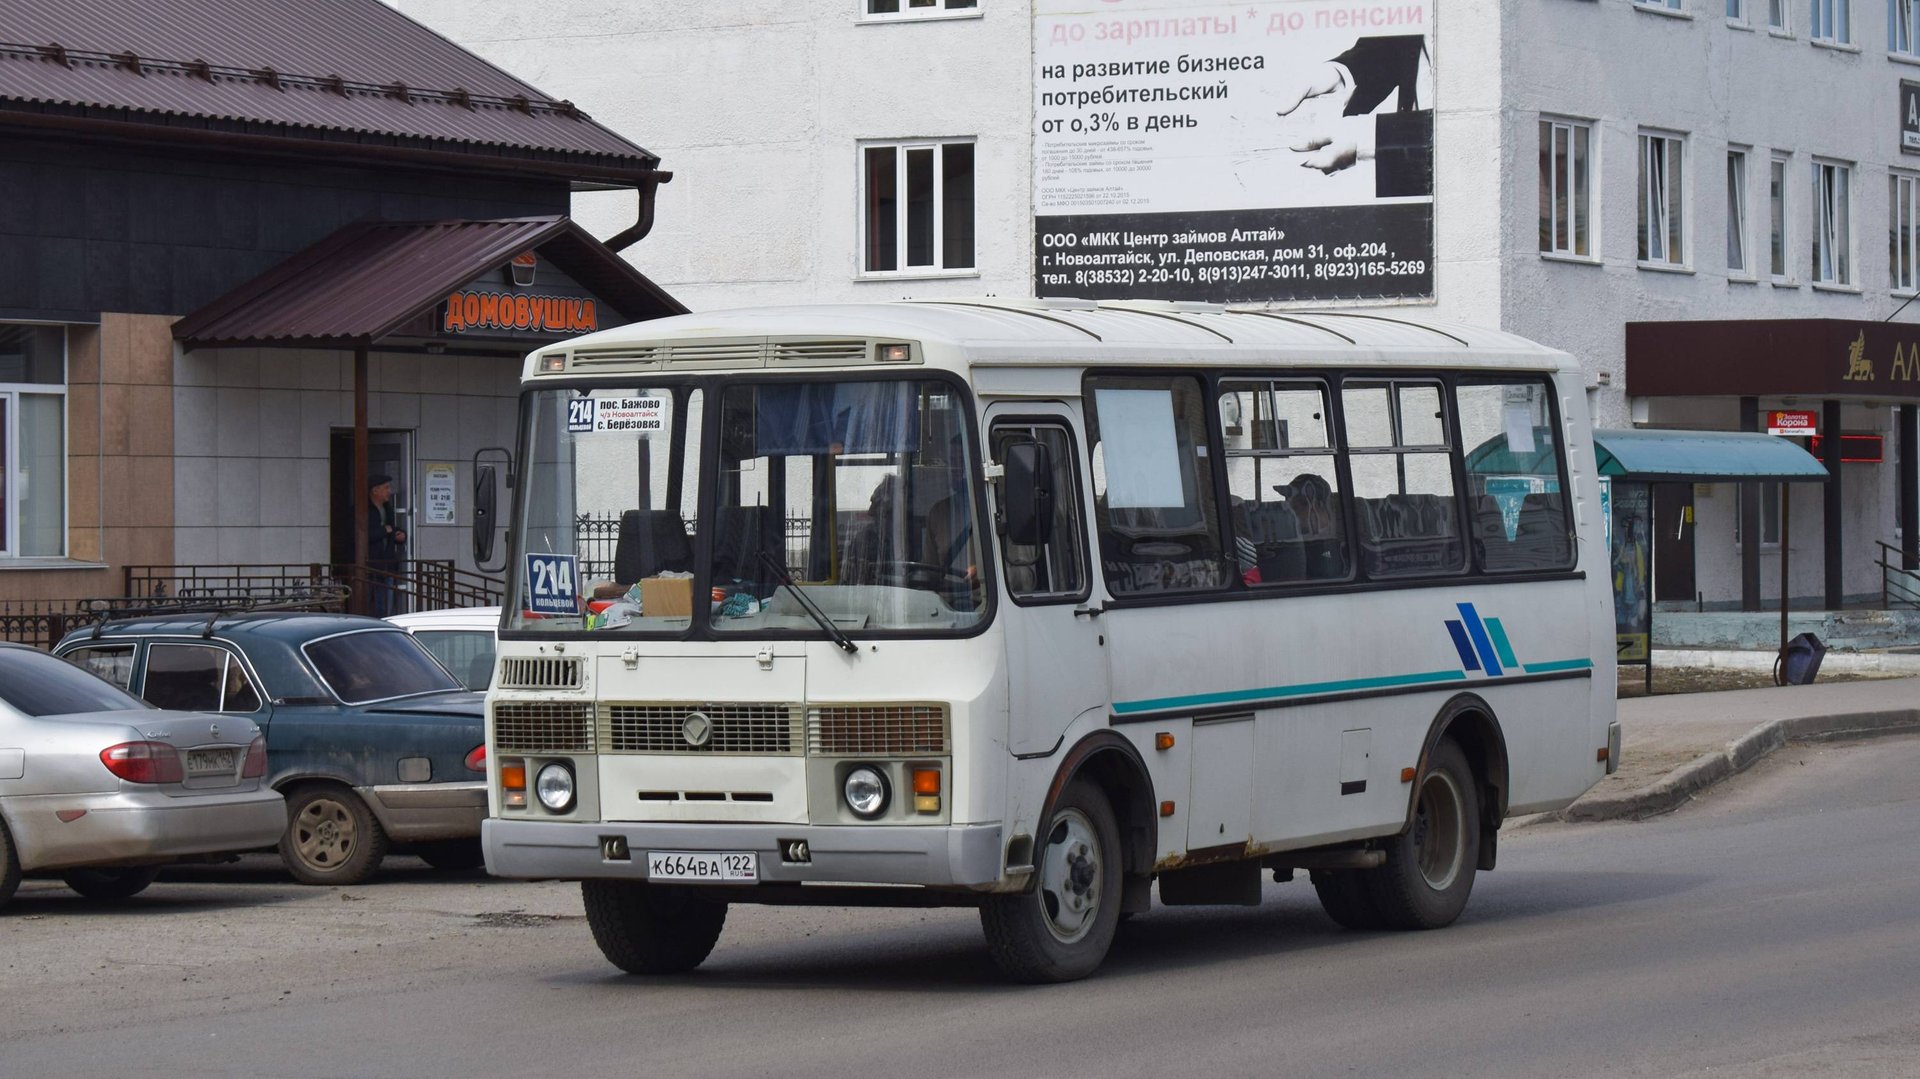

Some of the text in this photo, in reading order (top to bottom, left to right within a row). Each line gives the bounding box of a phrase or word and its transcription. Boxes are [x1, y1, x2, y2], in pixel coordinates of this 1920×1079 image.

[1050, 5, 1423, 46] до зарплаты до пенсии
[1042, 53, 1265, 82] на развитие бизнеса
[1042, 80, 1228, 109] потребительский
[1042, 118, 1064, 133] от
[1127, 115, 1139, 130] в
[1145, 114, 1198, 132] день
[1042, 227, 1286, 247] ООО «МКК Центр займов Алтай»
[1042, 242, 1387, 267] г. Новоалтайск, ул. Деповская, дом 31, оф.204
[1042, 260, 1426, 287] тел. 8(38532) 2-20-10, 8(913)247-3011, 8(923)165-5269
[445, 291, 597, 332] ДОМОВУШКА
[569, 400, 592, 424] 214
[600, 399, 660, 410] пос. Бажово
[612, 410, 658, 418] Новоалтайск
[597, 418, 660, 431] с. Берёзовка
[1777, 418, 1808, 427] Корона
[533, 559, 573, 596] 214
[535, 597, 575, 608] КОЛЬЦЕВОЙ
[654, 855, 751, 876] К664ВА 122
